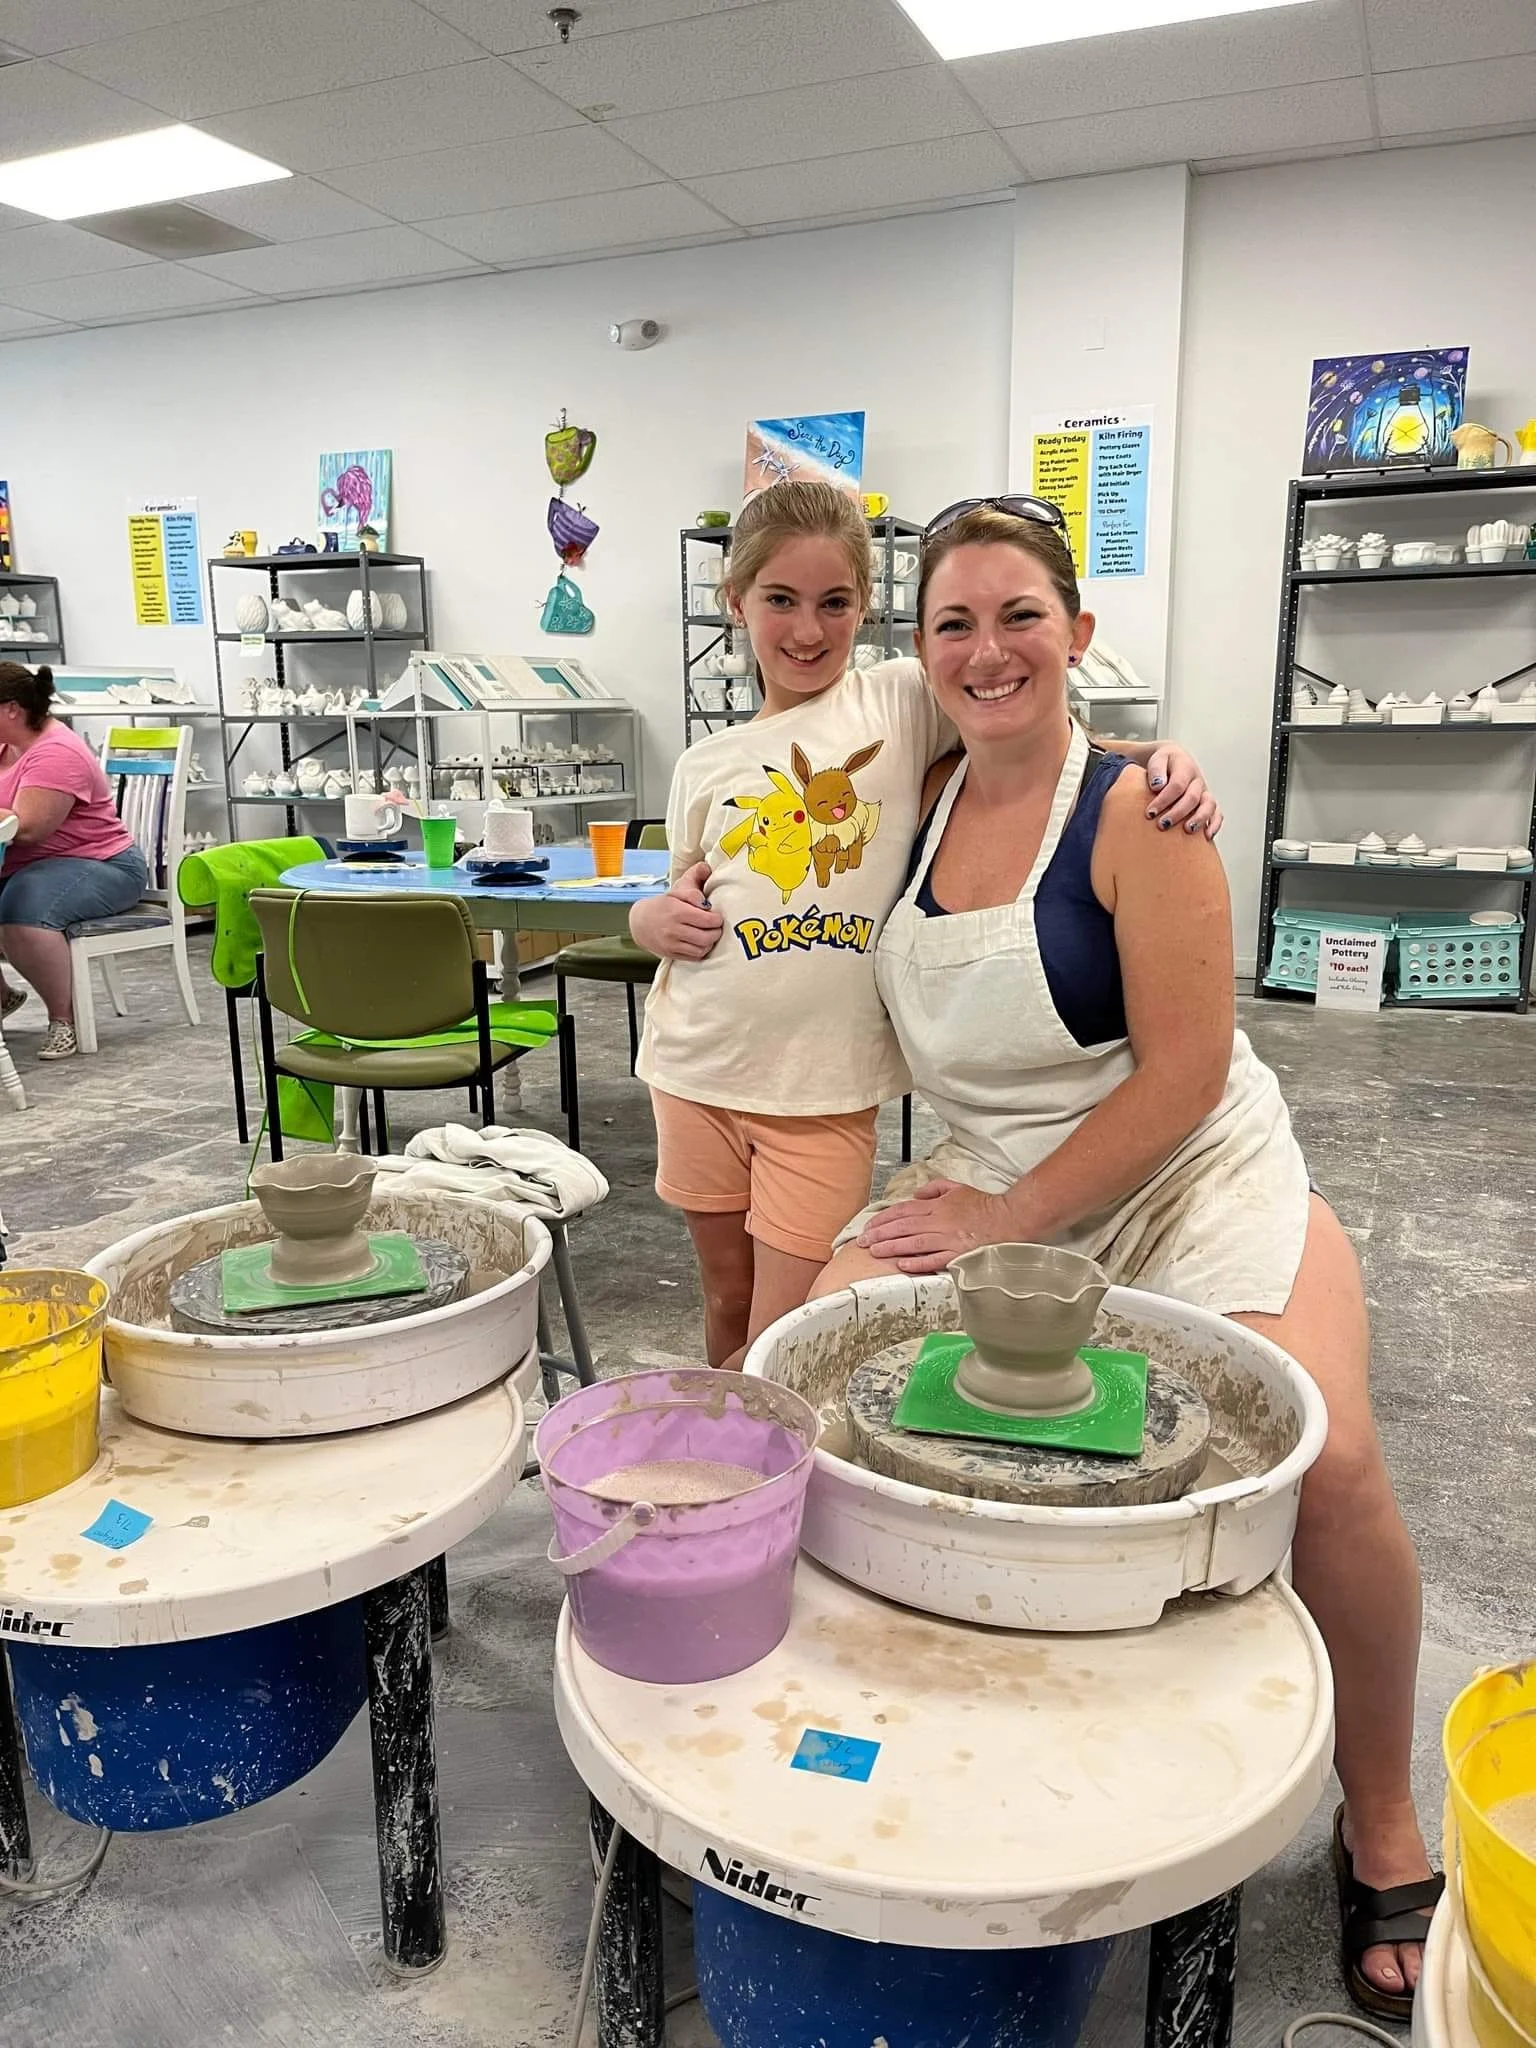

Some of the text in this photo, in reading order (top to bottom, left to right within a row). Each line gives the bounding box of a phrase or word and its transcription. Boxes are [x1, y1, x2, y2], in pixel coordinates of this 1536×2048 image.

[1064, 416, 1119, 428] Ceramics
[1037, 435, 1087, 446] Ready Today
[1098, 430, 1143, 441] Kiln Firing
[827, 441, 856, 469] Day
[144, 504, 177, 512] Ceramics
[1068, 510, 1082, 518] price
[1325, 937, 1377, 948] Unclaimed
[1331, 948, 1369, 960] Pottery
[1346, 964, 1369, 973] each!
[0, 1608, 75, 1638] idec
[700, 1847, 822, 1917] Nidec
